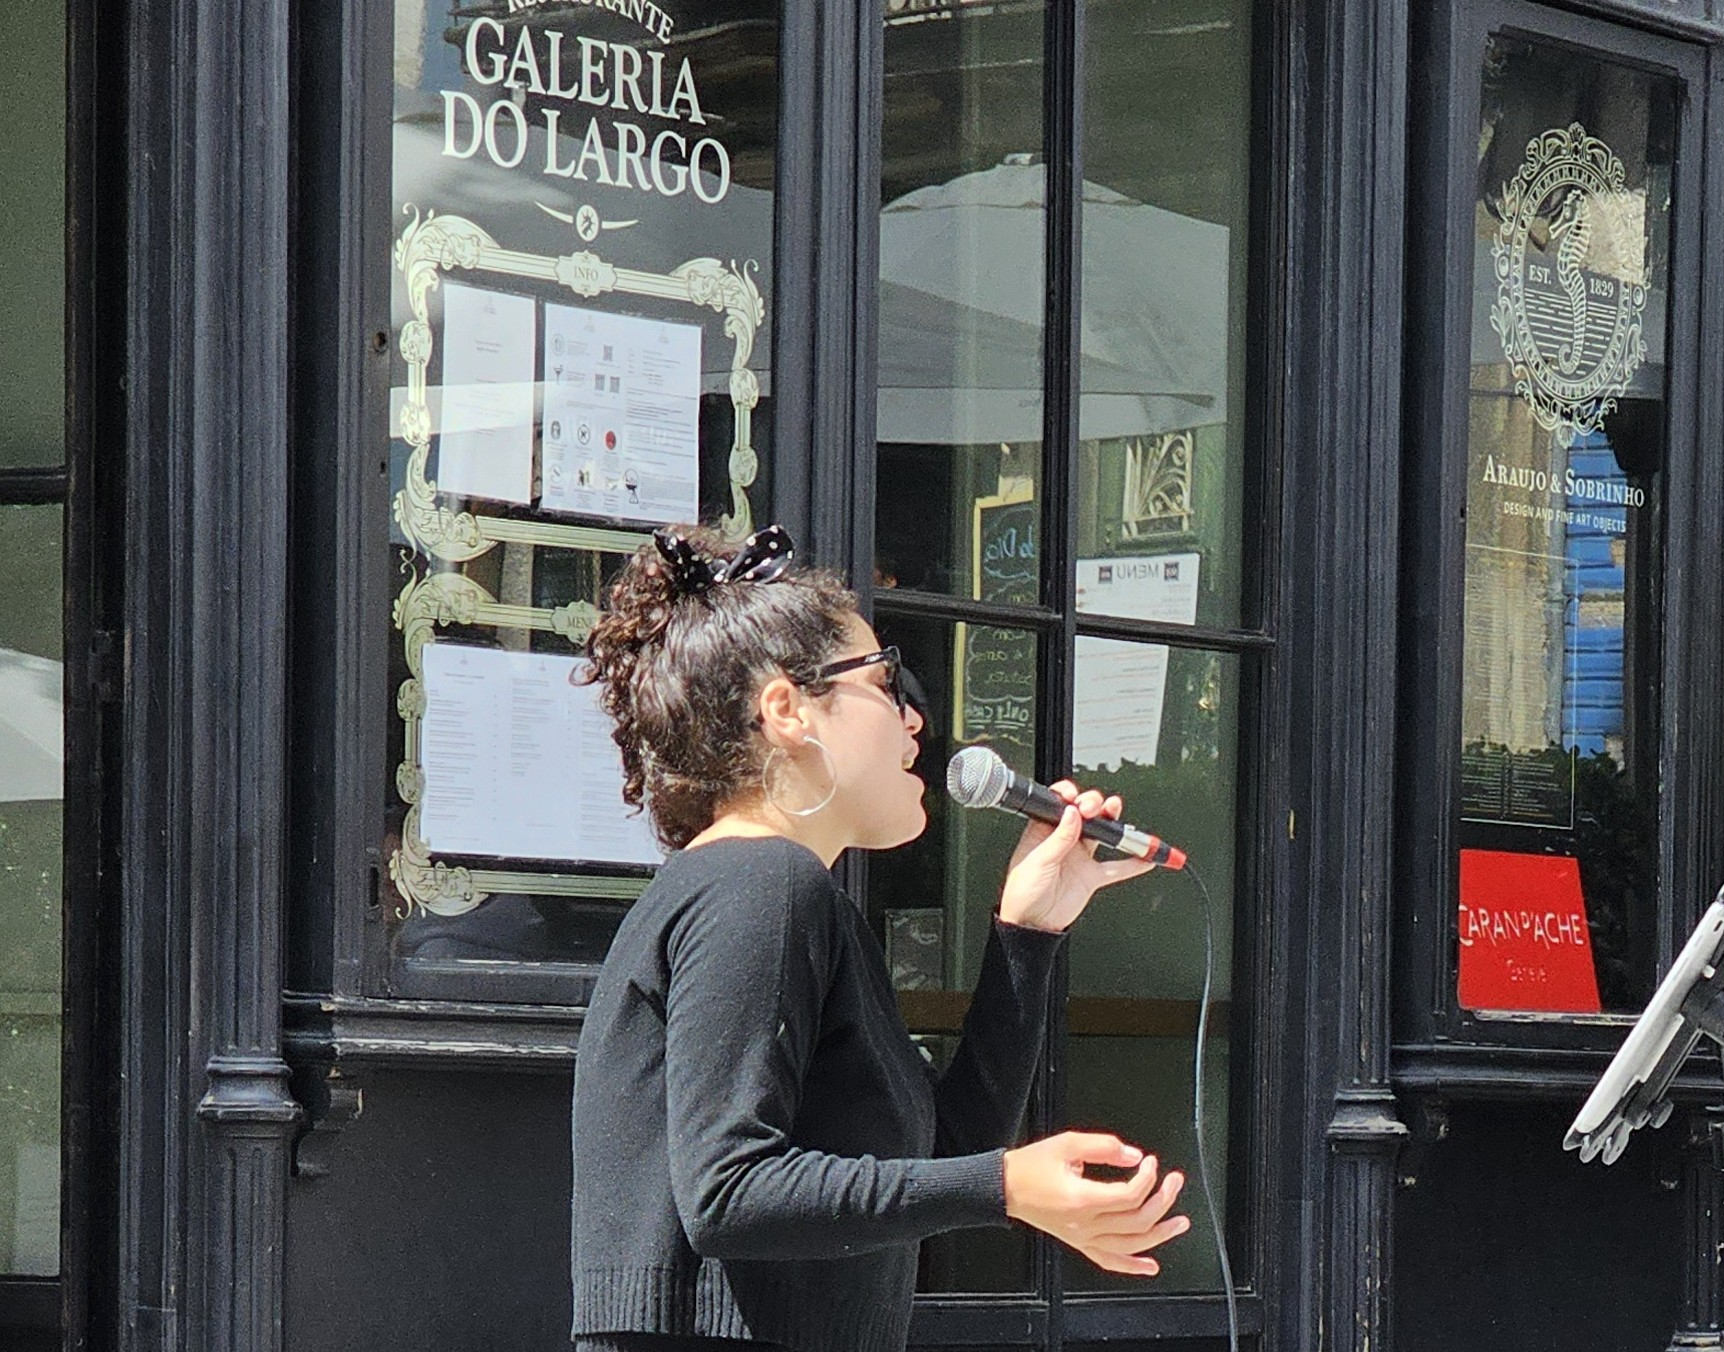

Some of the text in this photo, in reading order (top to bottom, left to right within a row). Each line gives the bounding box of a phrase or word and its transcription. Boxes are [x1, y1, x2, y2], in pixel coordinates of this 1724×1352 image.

[465, 16, 708, 126] GALERIA
[440, 89, 731, 204] DO LARGO
[573, 266, 599, 282] INFO
[1529, 264, 1552, 285] EST.
[1590, 278, 1614, 298] 1829
[1482, 453, 1645, 508] ARAUJO & SOBRINHO
[1503, 501, 1627, 534] DESIGN AND FINE ART OBJECTS
